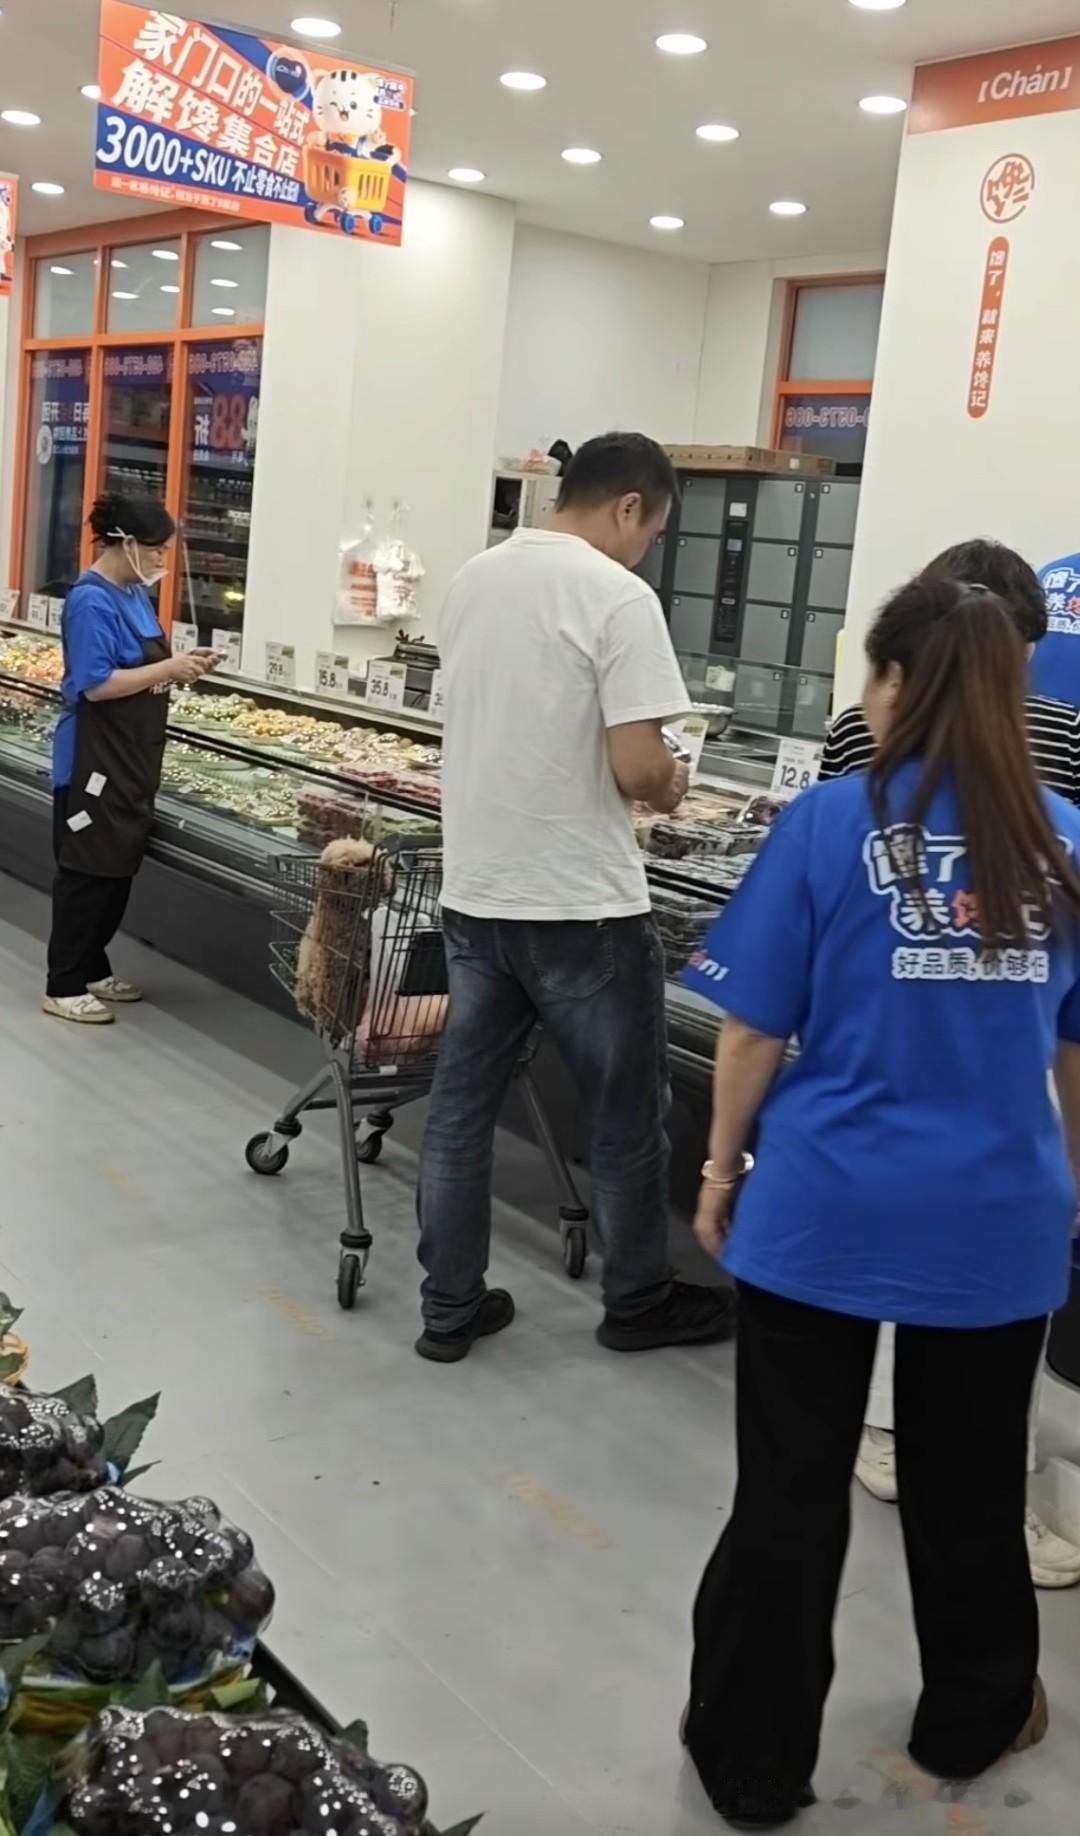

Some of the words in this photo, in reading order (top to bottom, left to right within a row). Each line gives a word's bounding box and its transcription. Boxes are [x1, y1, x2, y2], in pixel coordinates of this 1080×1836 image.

[111, 59, 300, 177] 解馋集合店
[133, 10, 312, 147] 家门口的一站式
[96, 115, 233, 187] 3000+SKU
[781, 764, 811, 790] 12.8
